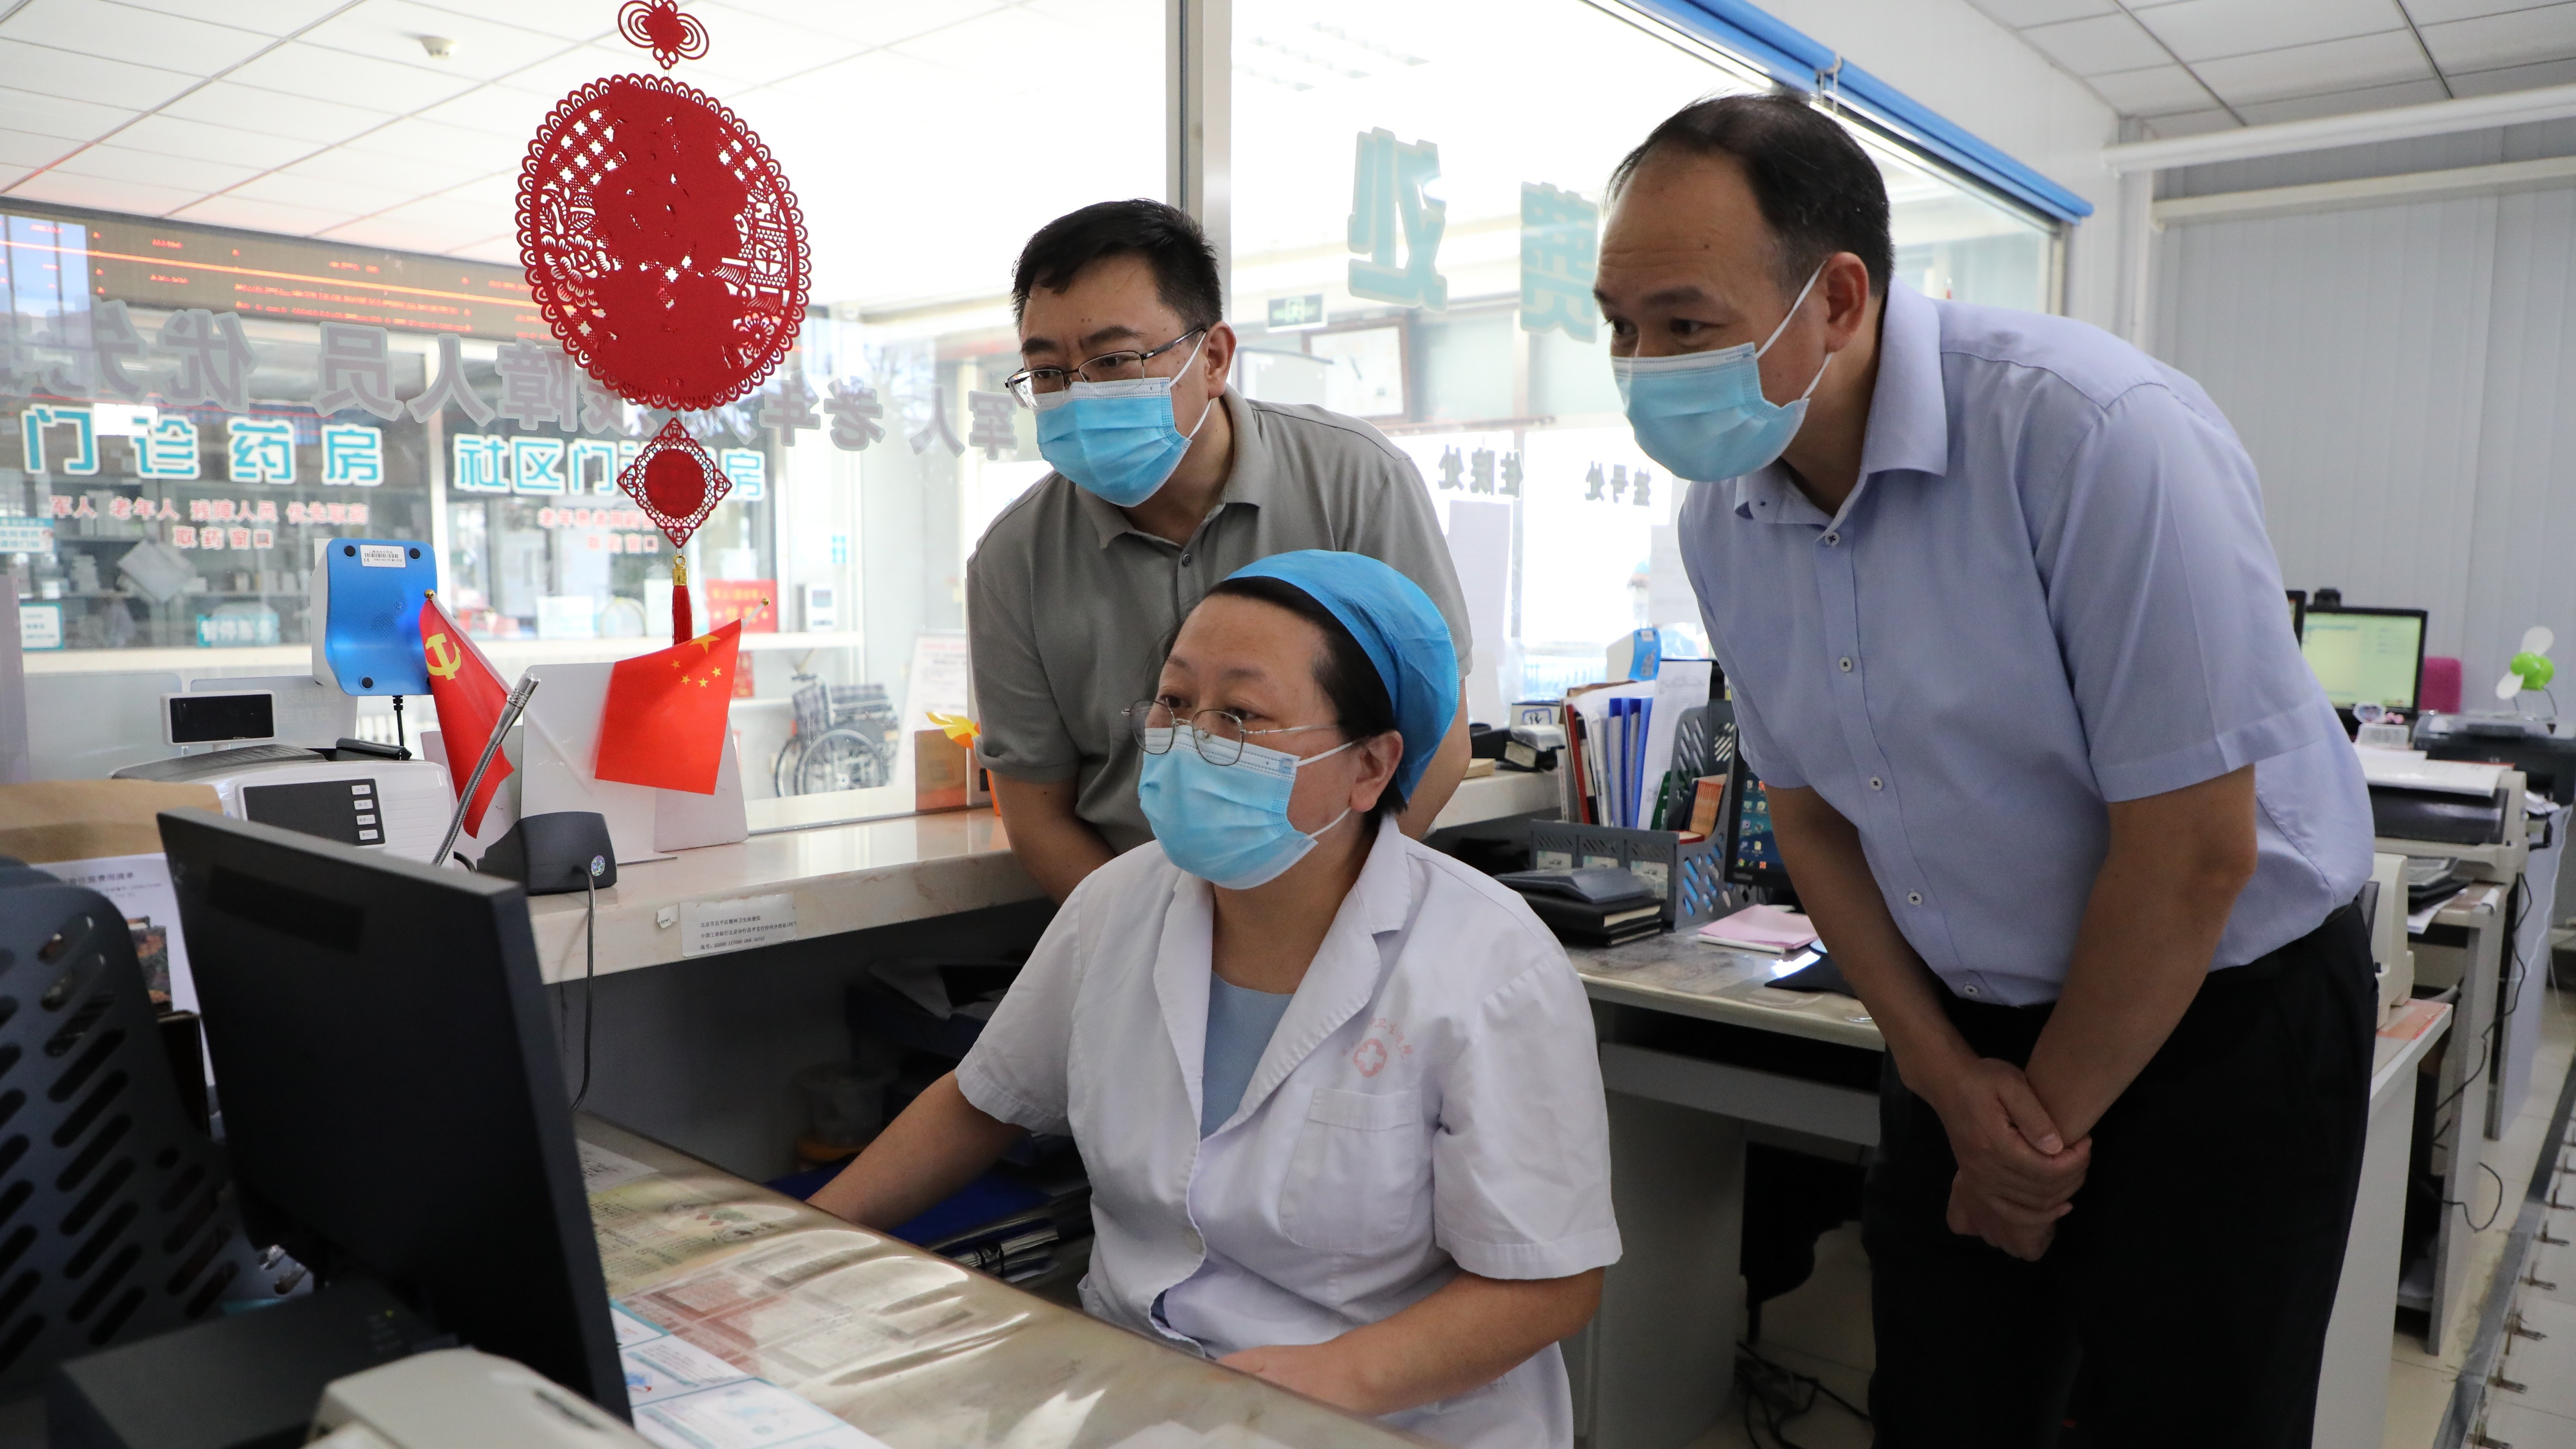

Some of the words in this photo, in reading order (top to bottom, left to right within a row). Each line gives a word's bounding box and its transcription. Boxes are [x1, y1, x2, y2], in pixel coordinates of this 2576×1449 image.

[21, 404, 384, 486] 门诊药房
[453, 433, 766, 501] 社区门房
[51, 496, 96, 519] 军人
[109, 497, 180, 521] 老年人
